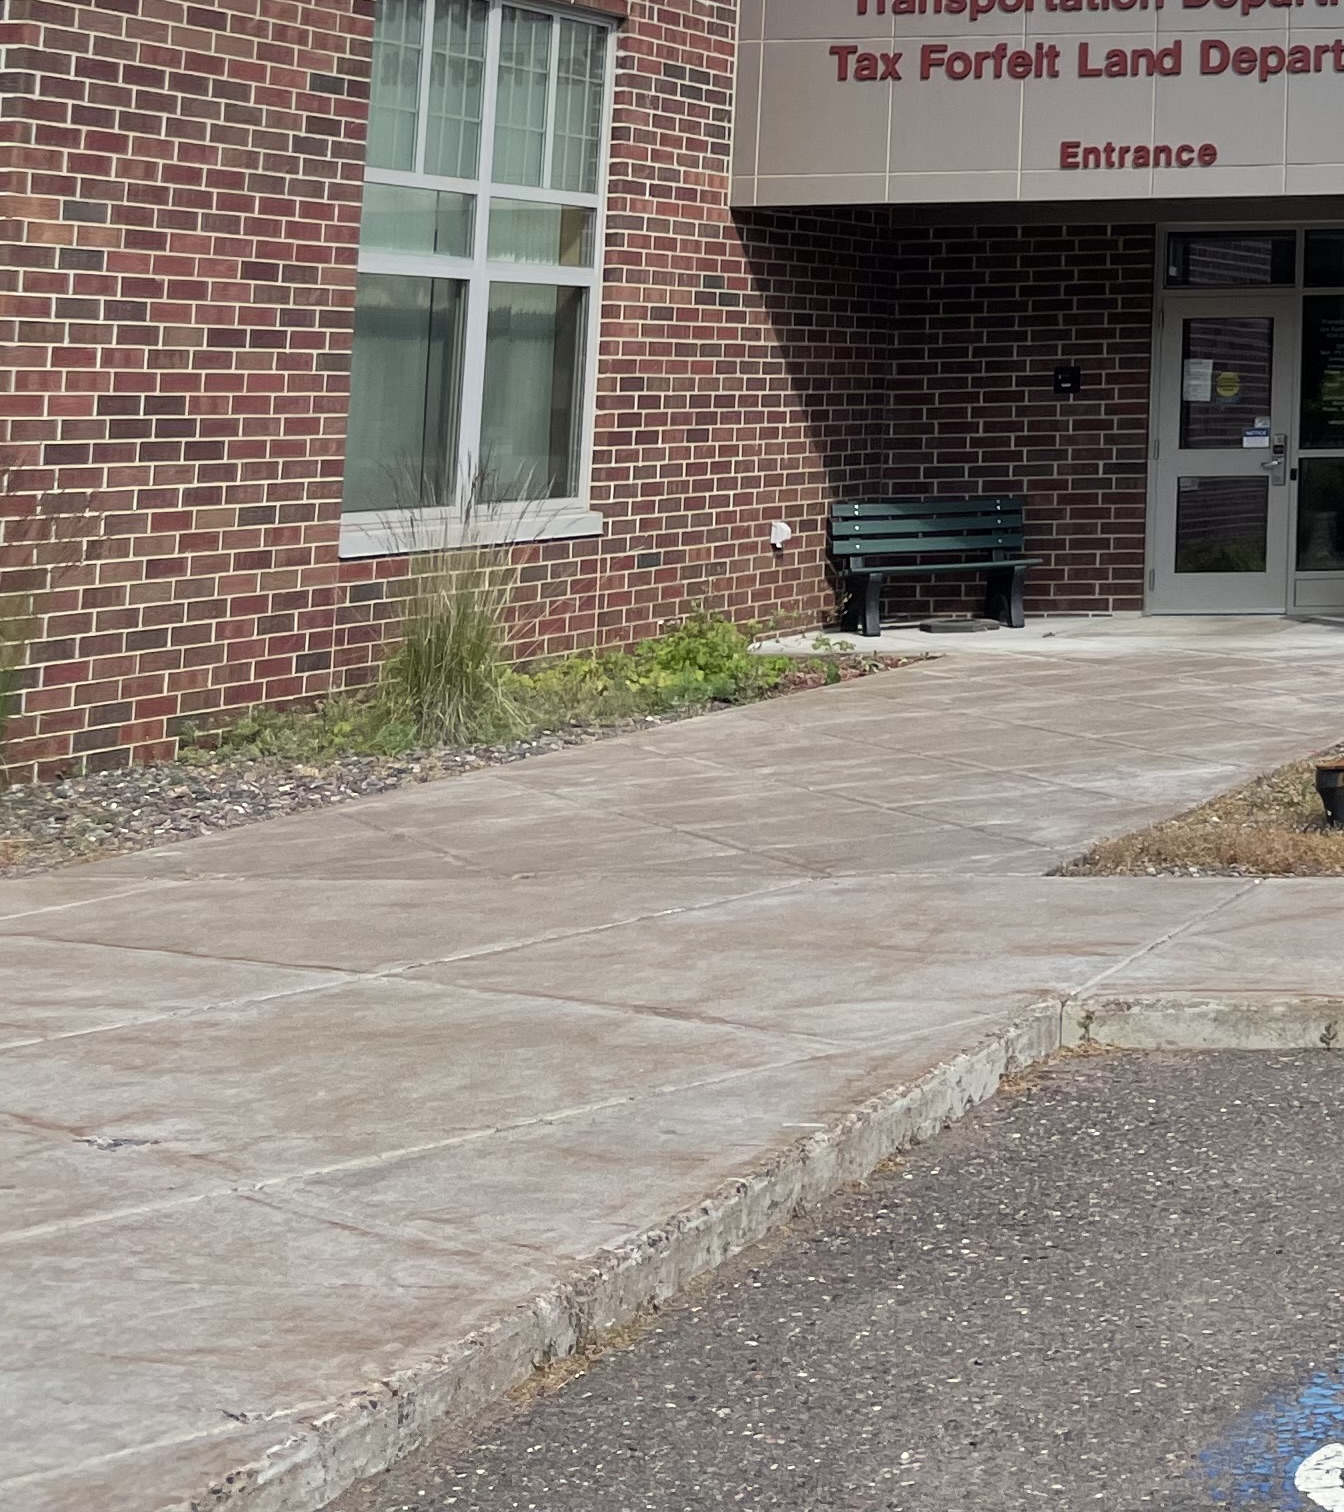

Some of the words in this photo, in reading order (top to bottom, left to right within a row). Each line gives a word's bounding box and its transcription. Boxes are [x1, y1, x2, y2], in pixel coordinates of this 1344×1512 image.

[830, 44, 903, 81] Tax
[920, 42, 1060, 80] Forfeit
[1078, 40, 1182, 77] Land
[1060, 141, 1217, 168] Entrance
